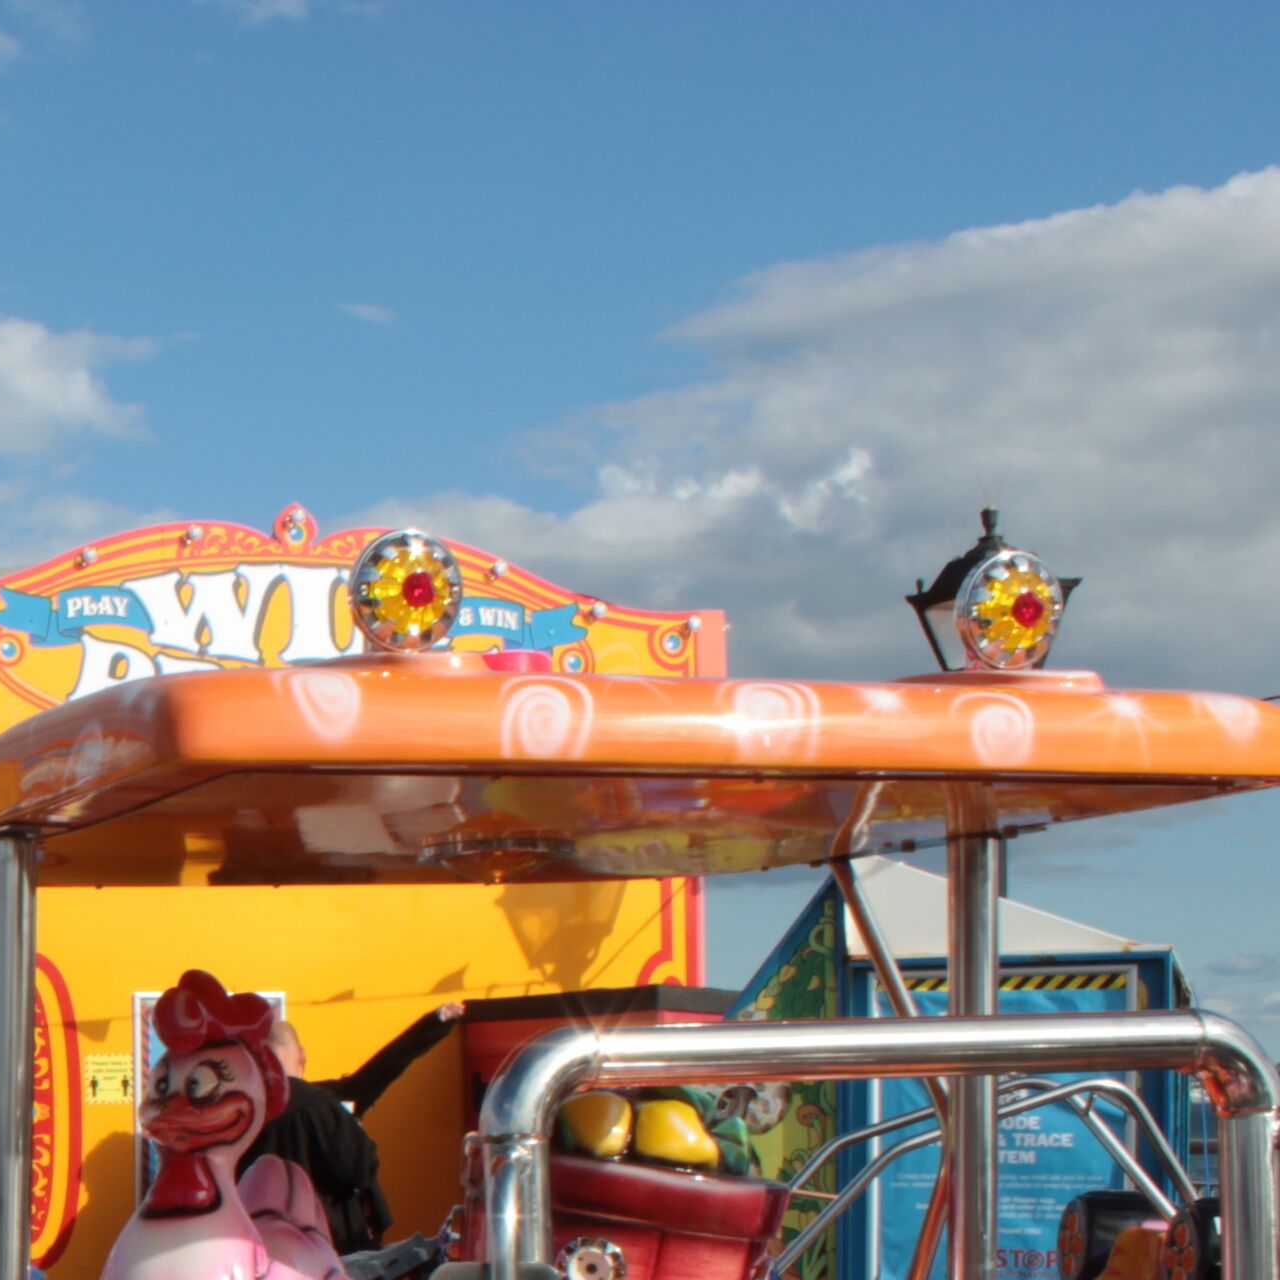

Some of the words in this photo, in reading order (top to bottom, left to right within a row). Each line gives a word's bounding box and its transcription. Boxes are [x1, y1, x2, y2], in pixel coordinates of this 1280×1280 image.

[66, 593, 129, 619] PLAY
[459, 607, 472, 627] &
[479, 606, 520, 631] WIN
[1001, 1115, 1041, 1130] ODE
